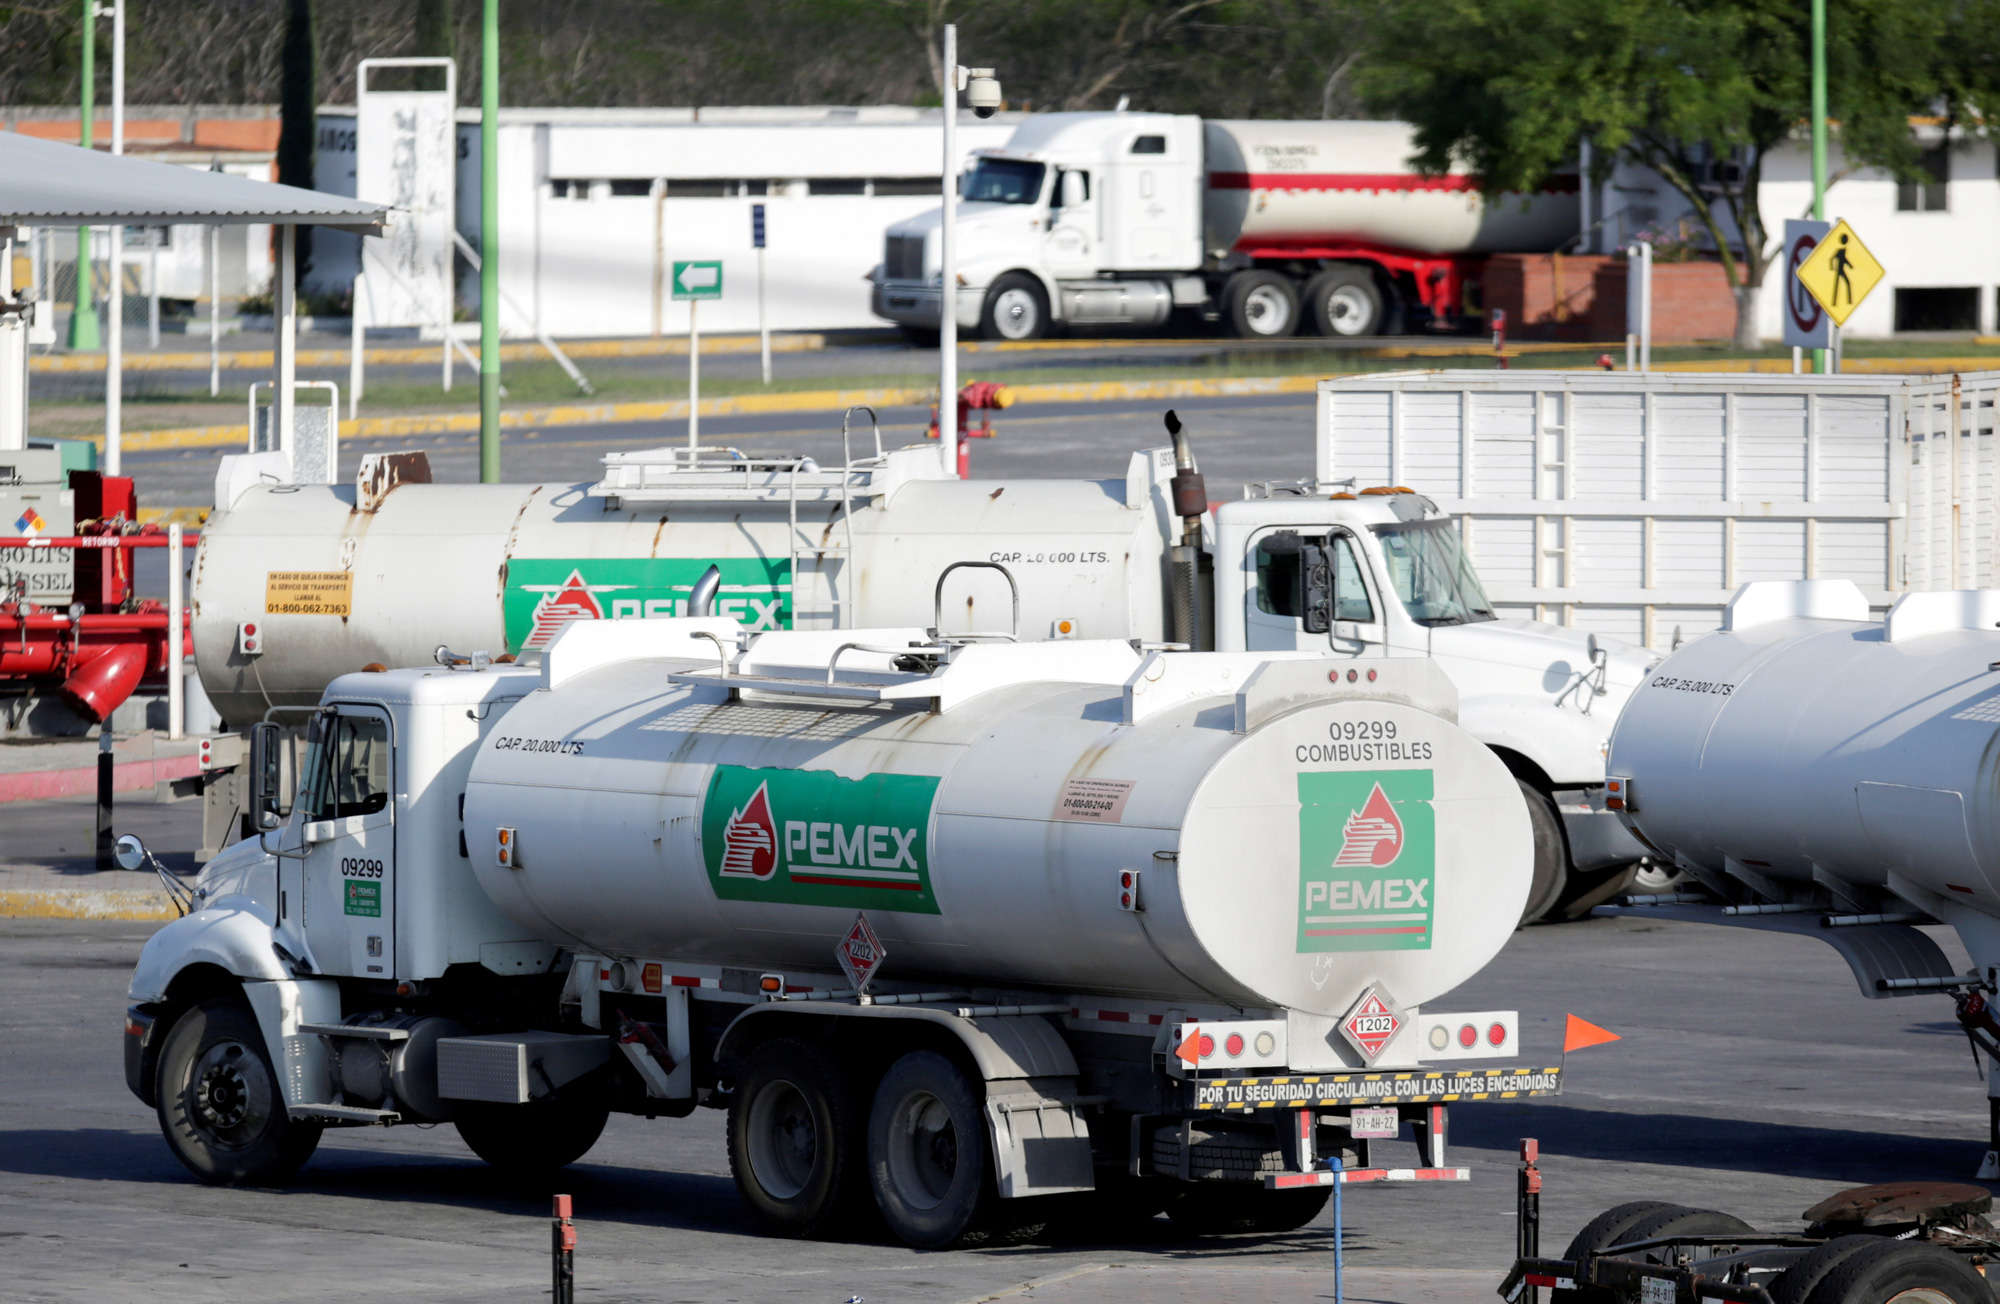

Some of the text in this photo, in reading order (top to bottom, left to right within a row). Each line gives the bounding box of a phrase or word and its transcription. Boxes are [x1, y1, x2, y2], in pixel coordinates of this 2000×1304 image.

[83, 536, 120, 547] RETORNO
[990, 552, 1022, 563] CAP.
[1080, 552, 1110, 563] LTS.
[268, 603, 347, 613] 01-800-062-7363
[611, 599, 784, 632] PEEX
[1652, 677, 1734, 696] CAP. 25,000 LTS.
[1329, 721, 1397, 740] 09299
[495, 737, 584, 755] CAP. 20,000 LTS.
[1295, 742, 1433, 762] COMBUSTIBLES
[784, 820, 918, 870] PEMEX
[341, 857, 383, 878] 09299
[1305, 878, 1429, 911] PEMEX
[1358, 1017, 1391, 1032] 1202
[1370, 1045, 1376, 1053] 3
[1199, 1074, 1557, 1103] POR TU SEGURIDAD CIRCULAMOS CON LAS LUCES ENCENDIDAS
